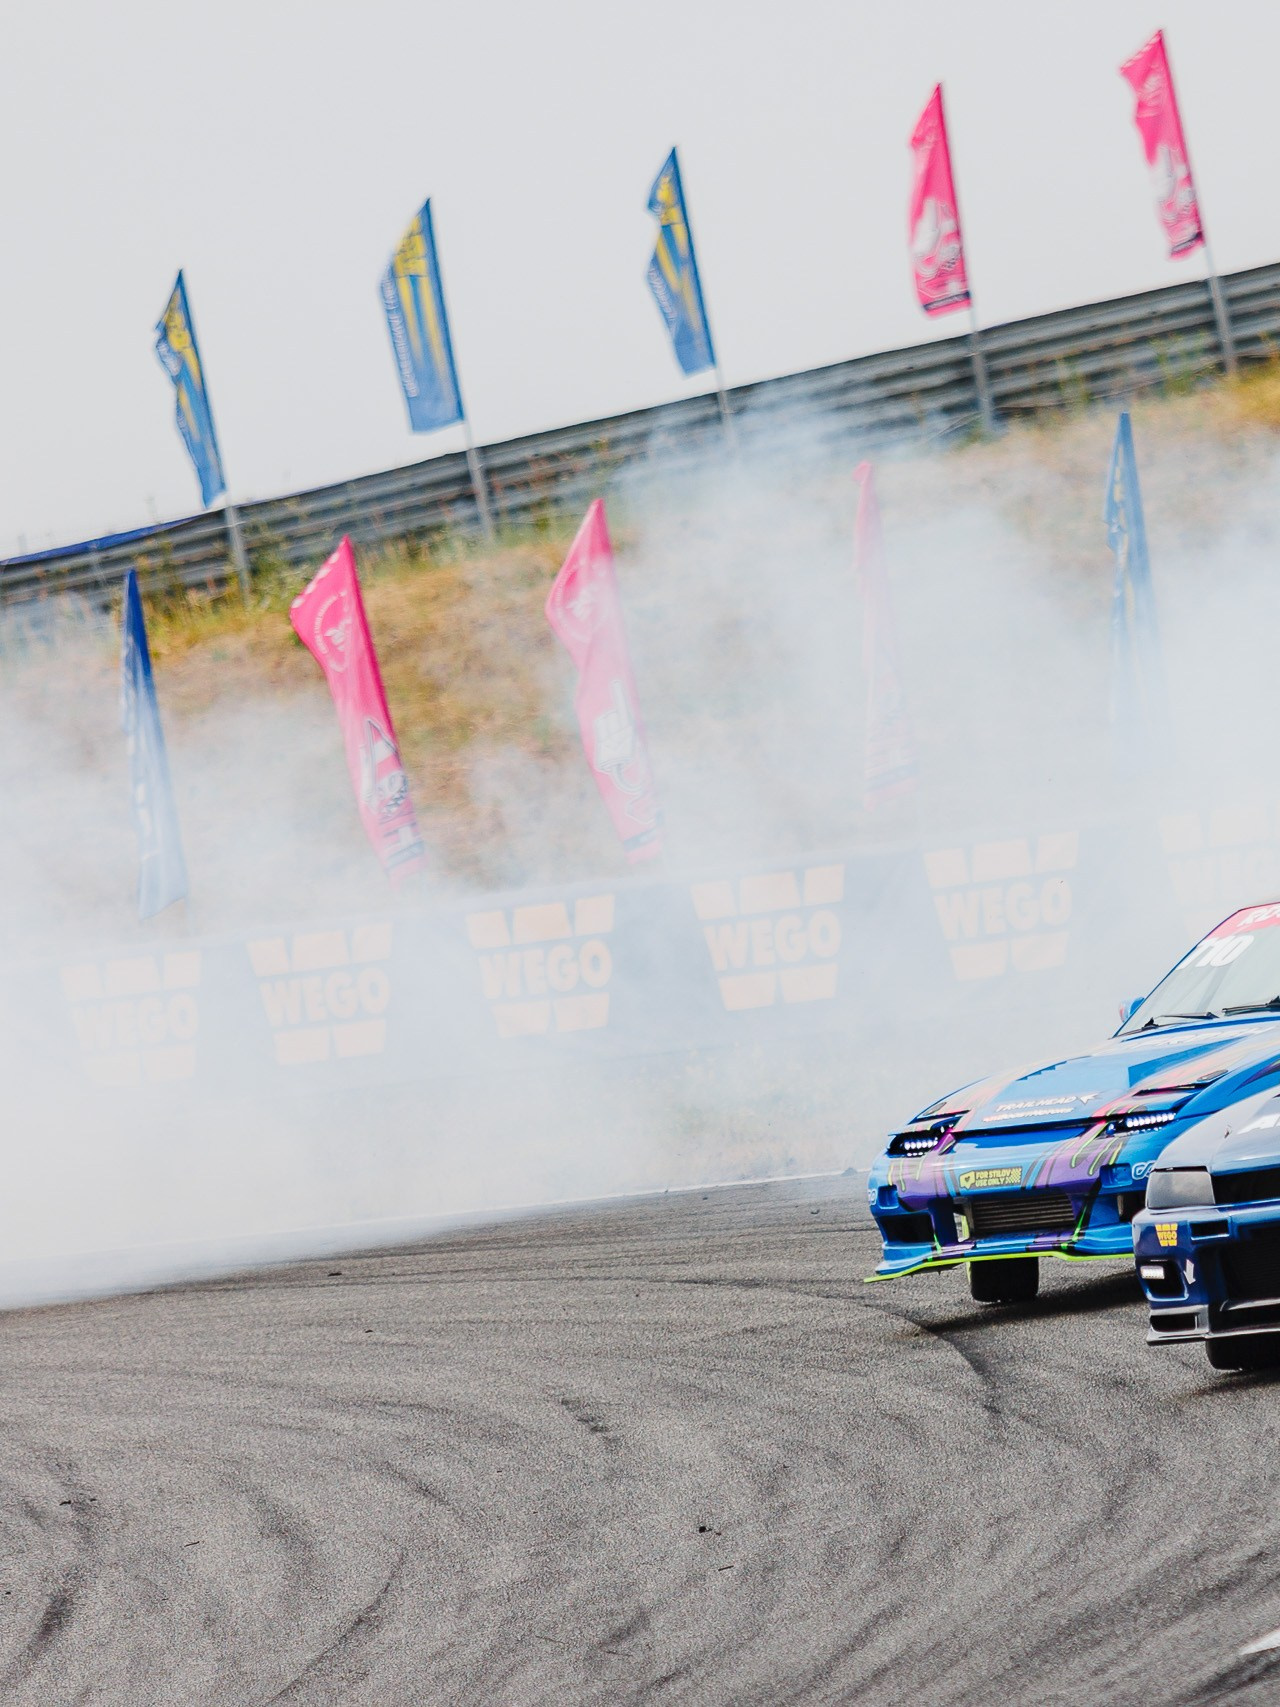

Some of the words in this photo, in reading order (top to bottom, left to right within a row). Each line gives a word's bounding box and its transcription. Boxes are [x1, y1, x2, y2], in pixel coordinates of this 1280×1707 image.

[933, 877, 1072, 941] WEGO
[477, 939, 613, 1000] WEGO
[703, 910, 842, 972] WEGO
[70, 994, 199, 1052] WEGO
[258, 968, 391, 1030] WEGO
[975, 1170, 989, 1180] FOR
[987, 1176, 1005, 1185] ONLY
[1156, 1231, 1178, 1241] WEGO
